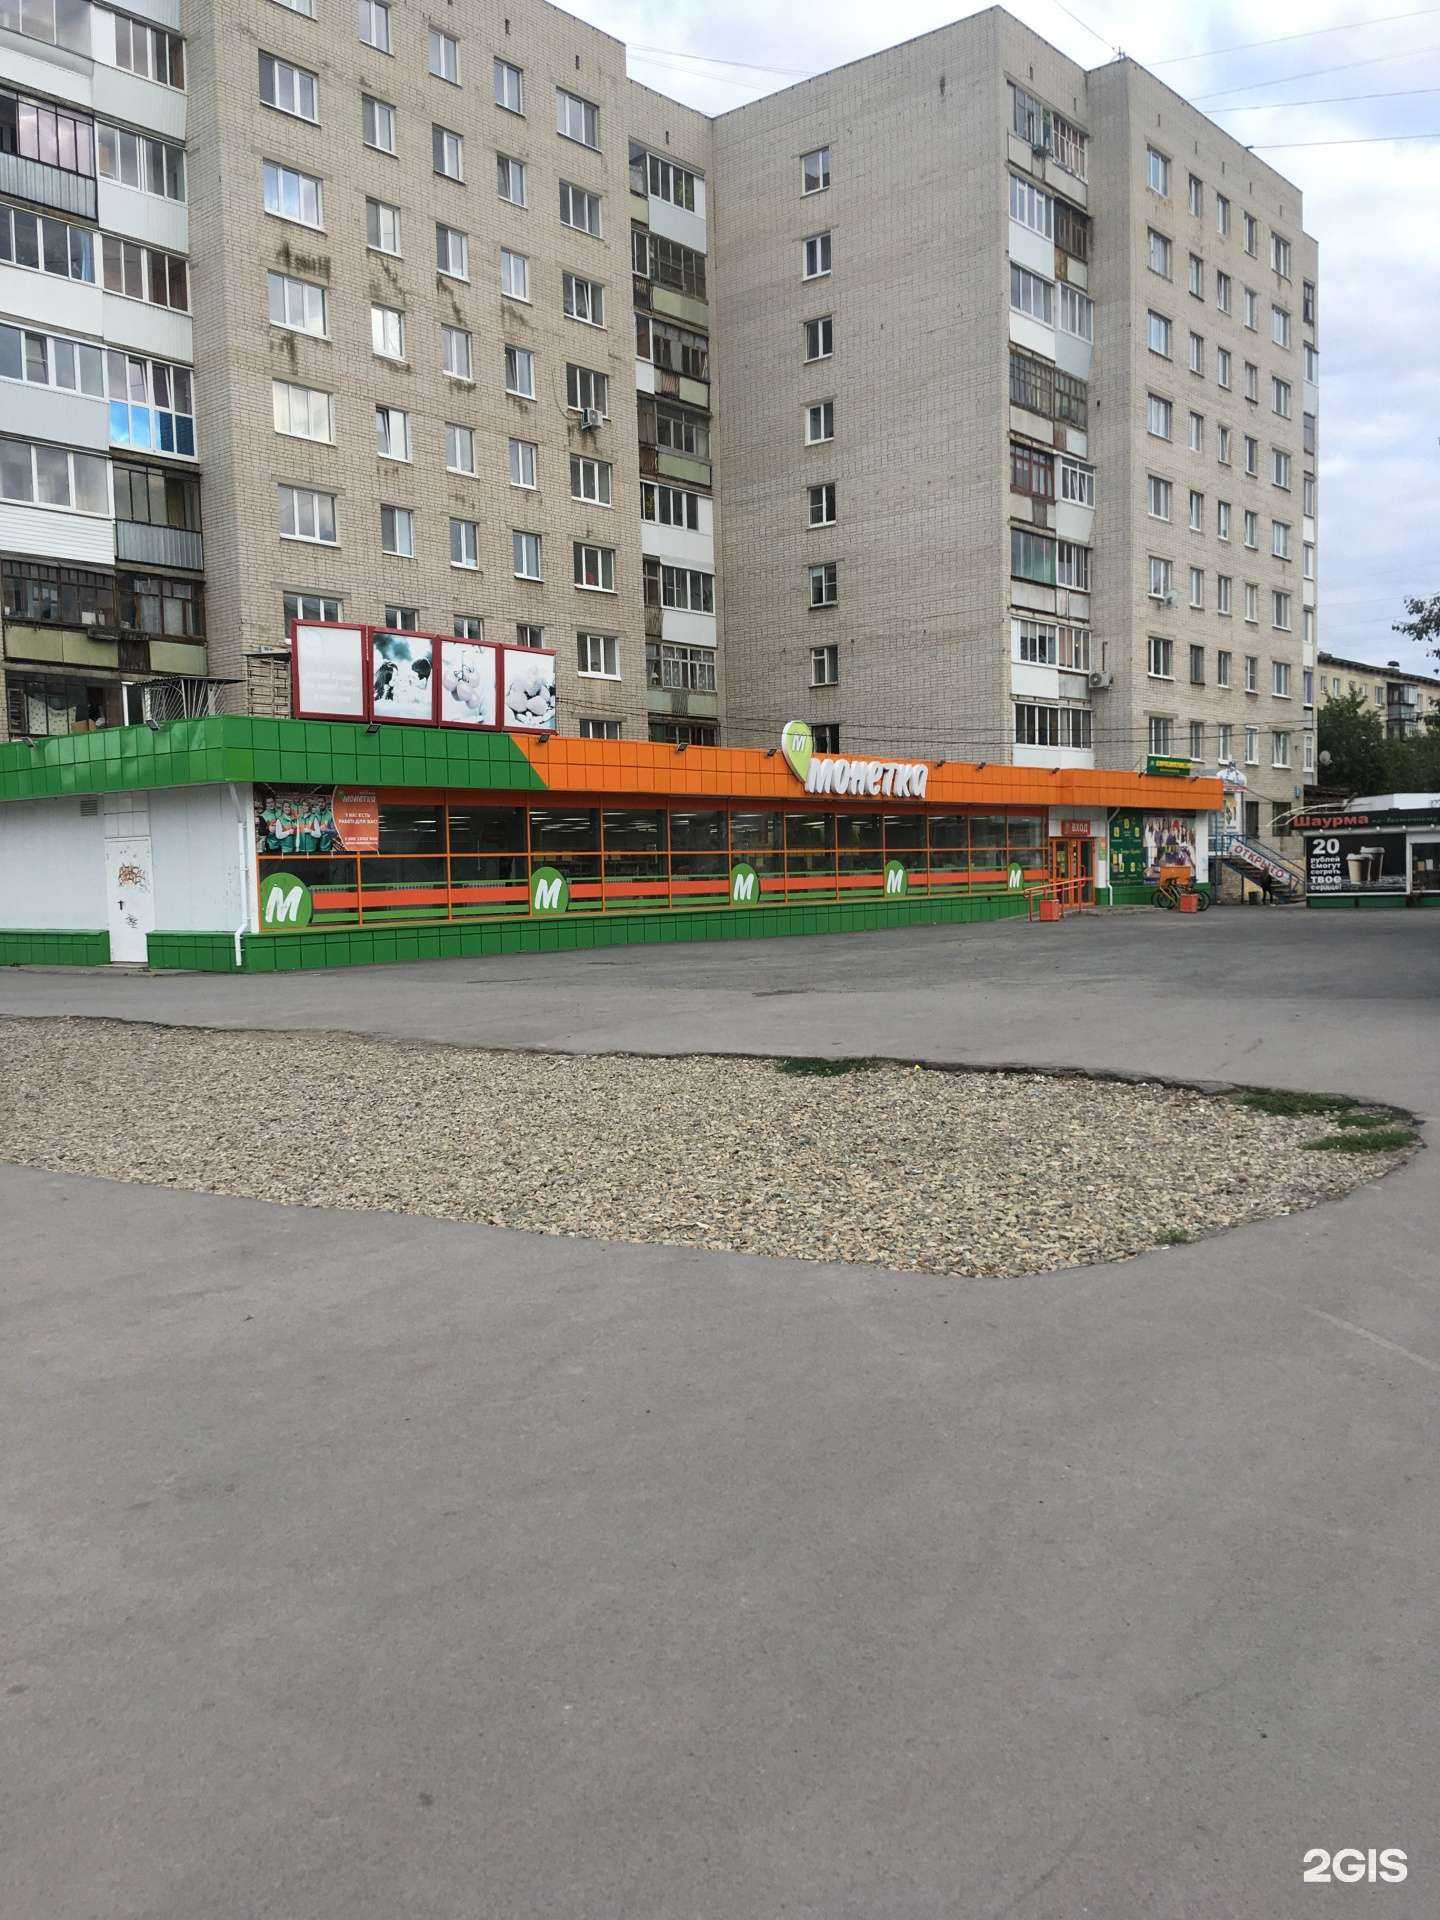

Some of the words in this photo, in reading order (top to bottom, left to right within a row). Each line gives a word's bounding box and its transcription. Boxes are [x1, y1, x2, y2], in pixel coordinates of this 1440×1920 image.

[1071, 821, 1089, 834] ВХОД
[1293, 814, 1370, 830] Шаурма
[1312, 838, 1340, 855] 20
